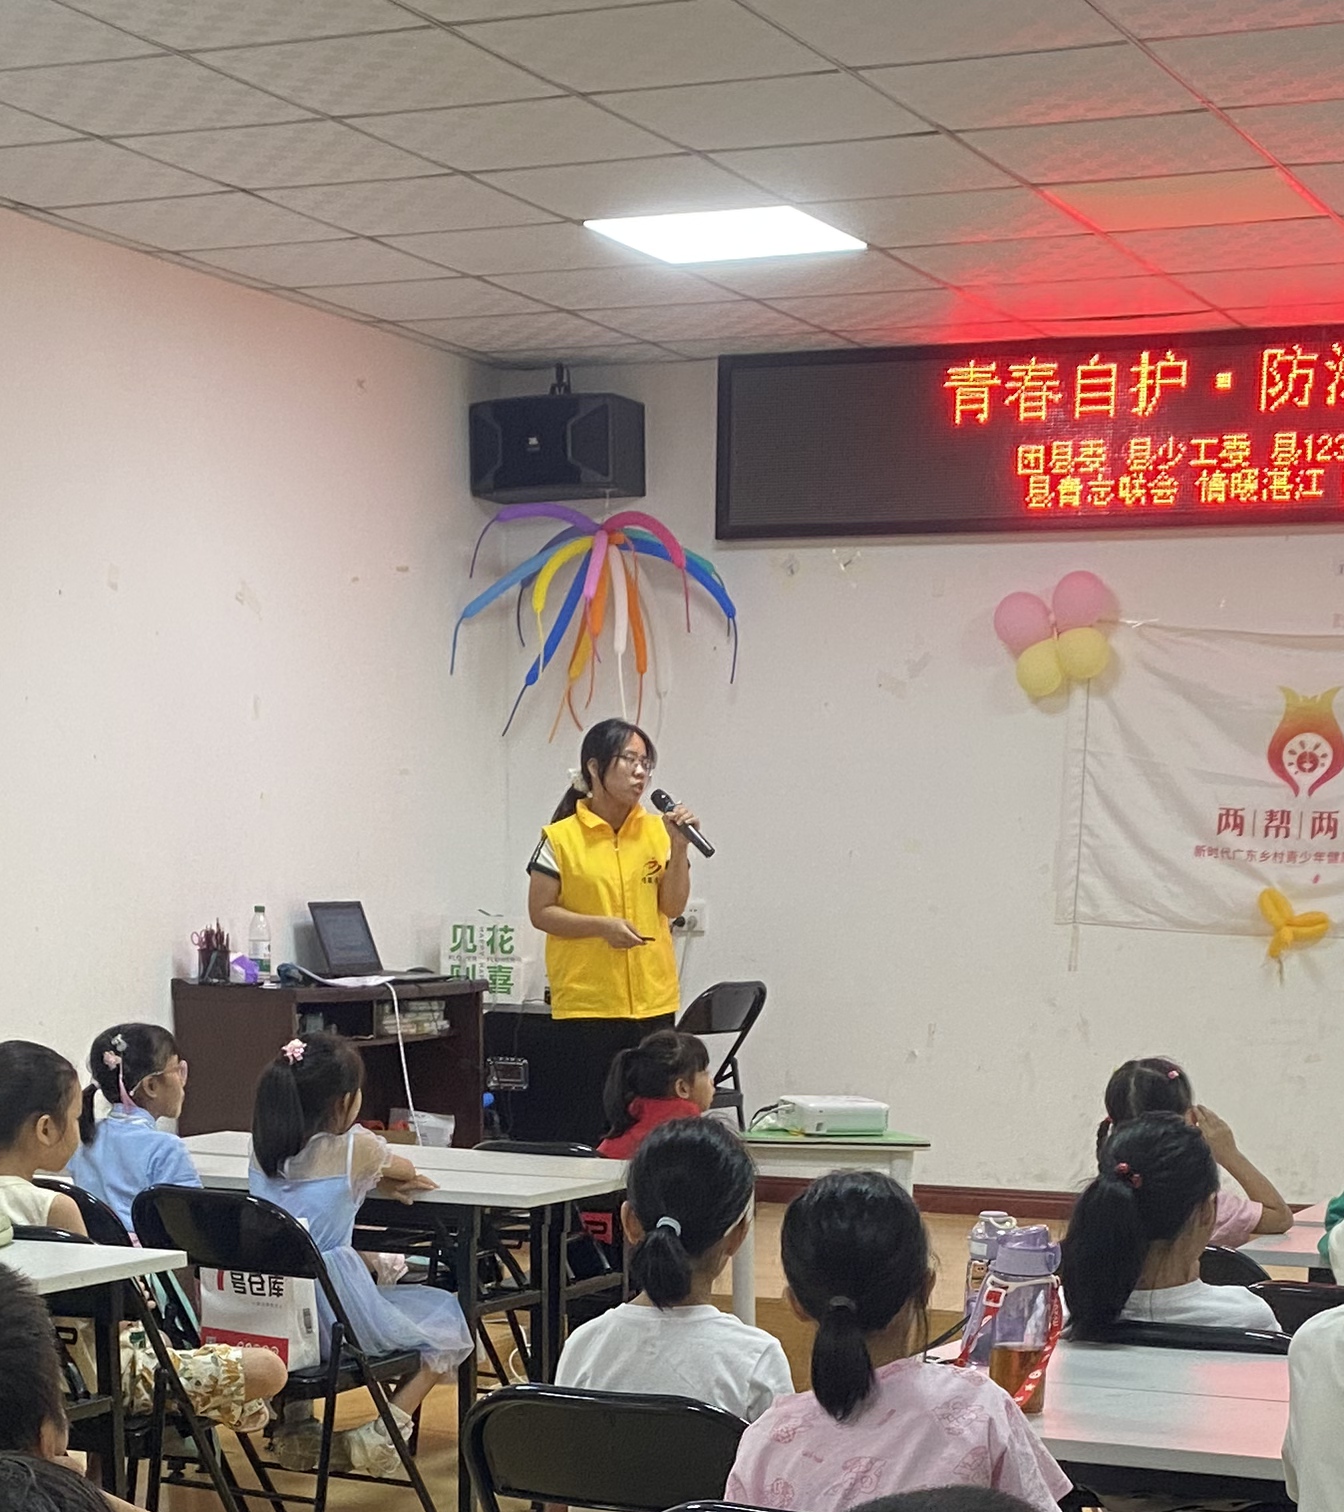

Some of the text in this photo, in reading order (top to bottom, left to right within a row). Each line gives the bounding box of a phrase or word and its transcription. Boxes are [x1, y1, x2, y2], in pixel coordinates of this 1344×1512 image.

[1017, 440, 1107, 475] 团县委
[1126, 433, 1251, 470] 县少工委
[1025, 471, 1179, 508] 县青志联会
[1194, 466, 1325, 503] 情暖湛江
